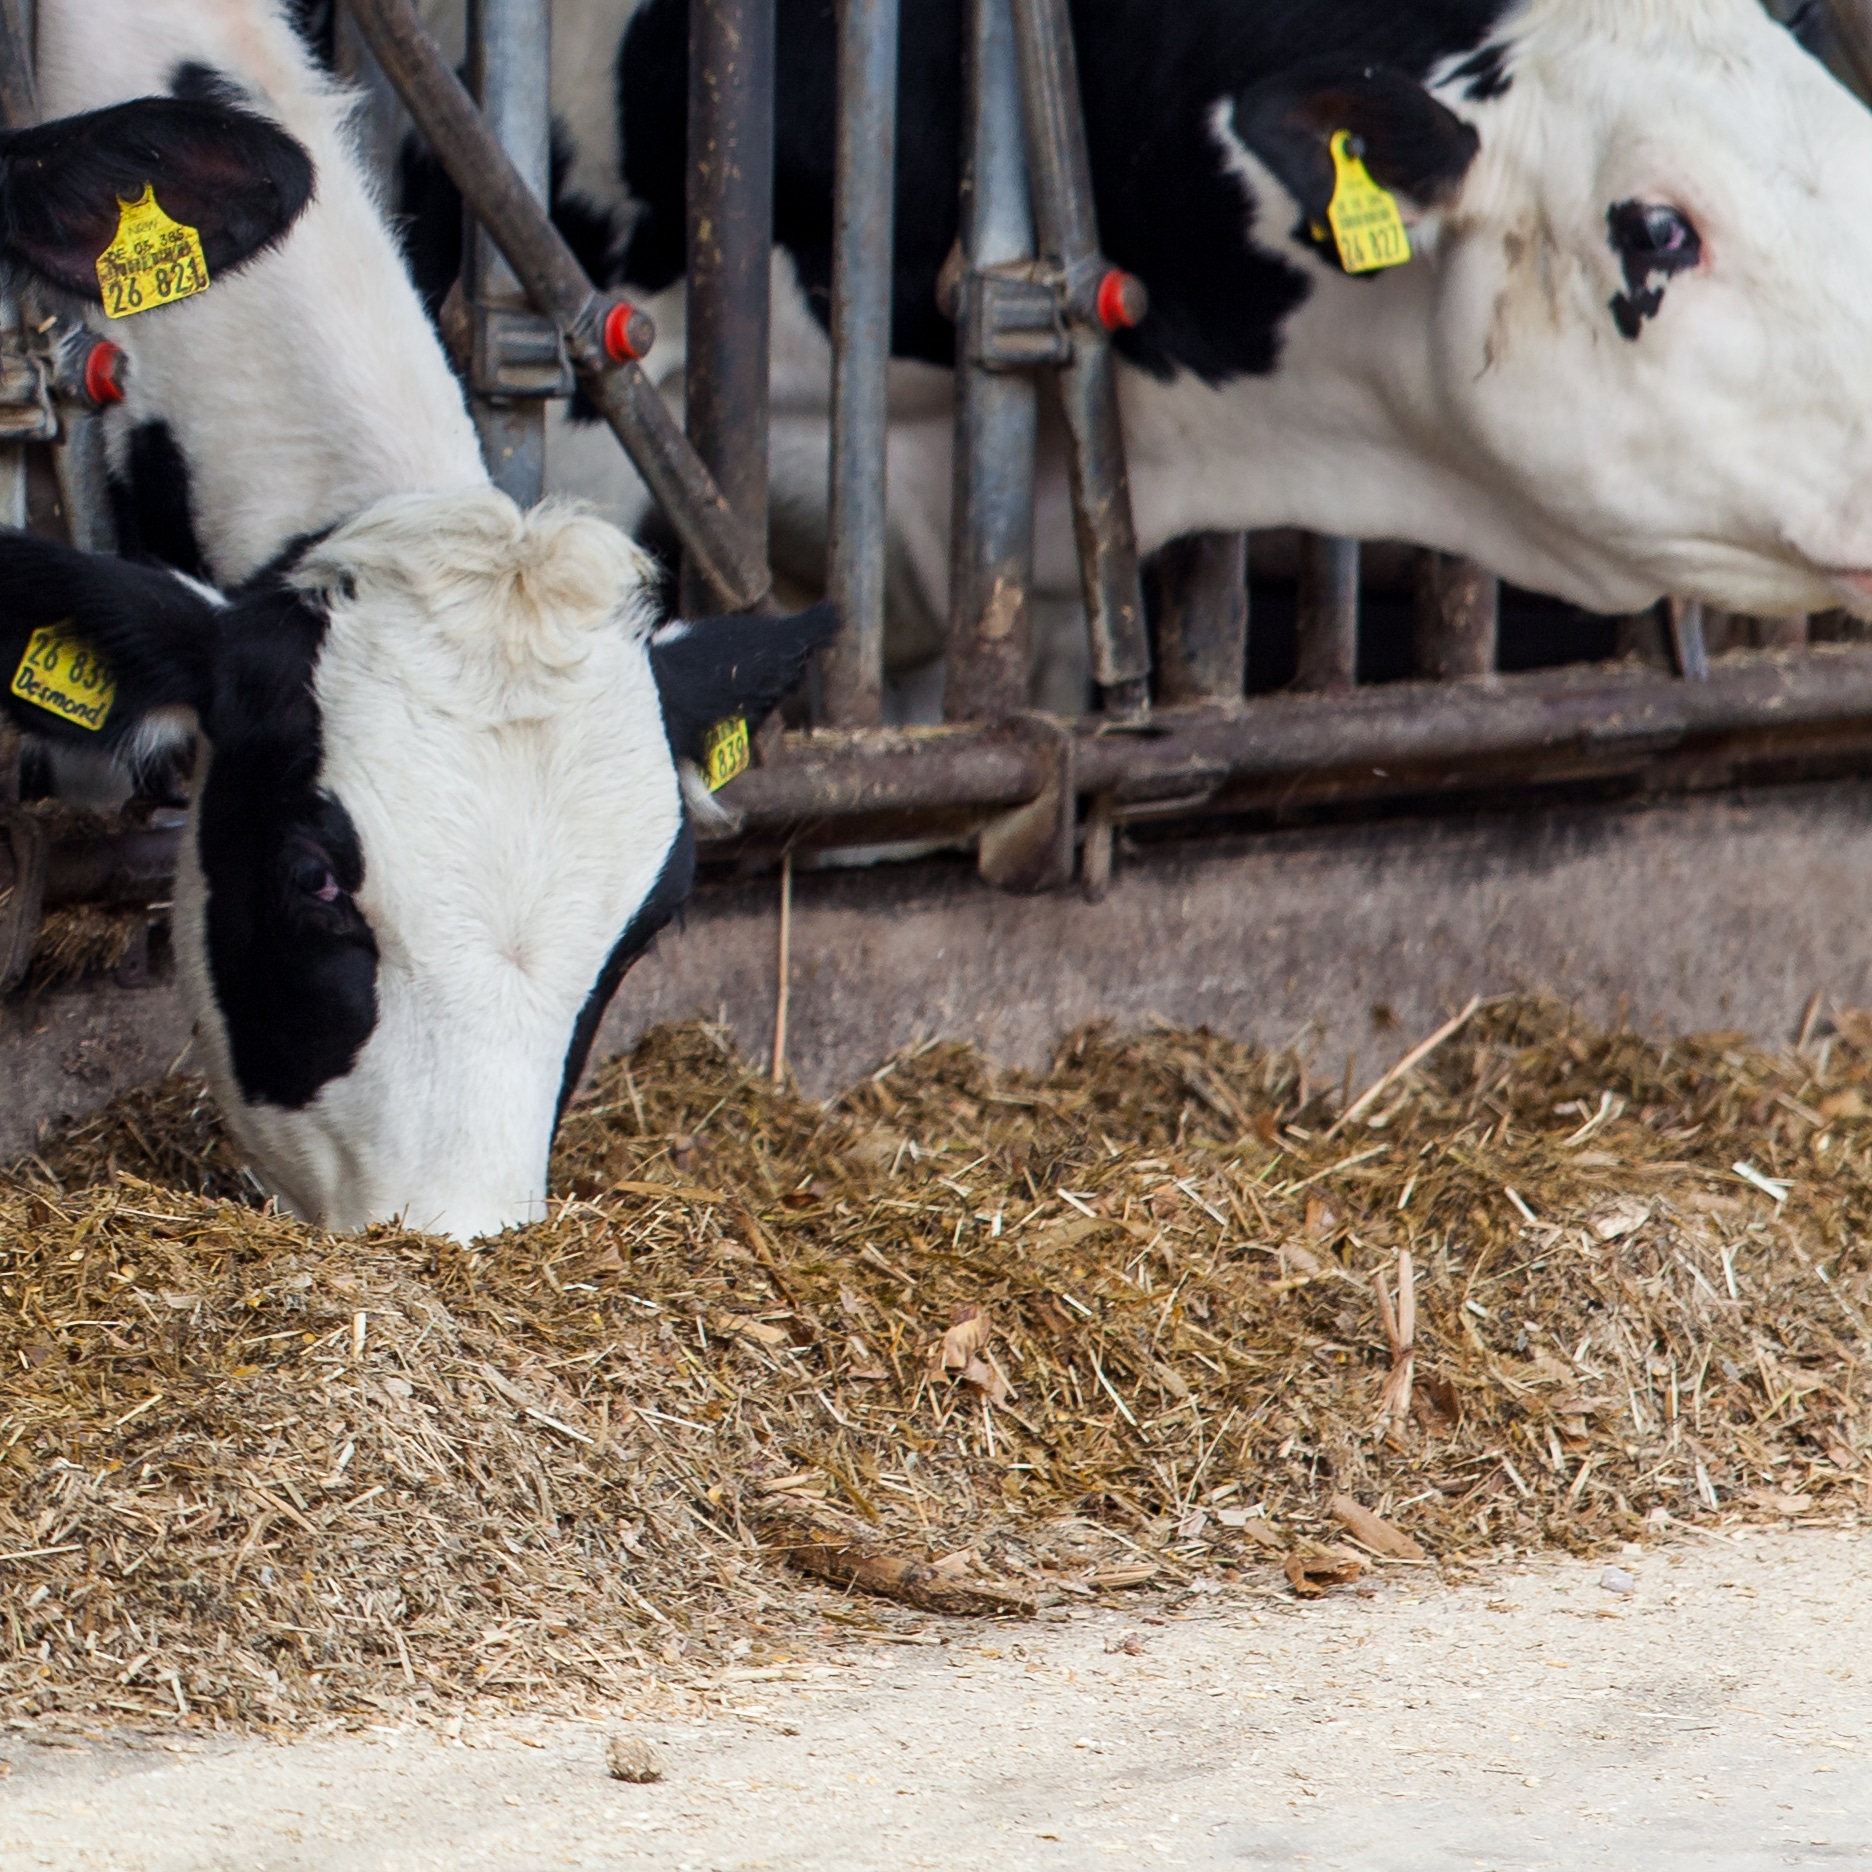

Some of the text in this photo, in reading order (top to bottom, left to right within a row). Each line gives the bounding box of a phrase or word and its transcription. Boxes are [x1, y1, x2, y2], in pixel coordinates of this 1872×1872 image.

[1341, 234, 1365, 267] 26
[108, 257, 201, 313] 26 821
[27, 633, 63, 672] 26
[15, 666, 106, 726] Desmond
